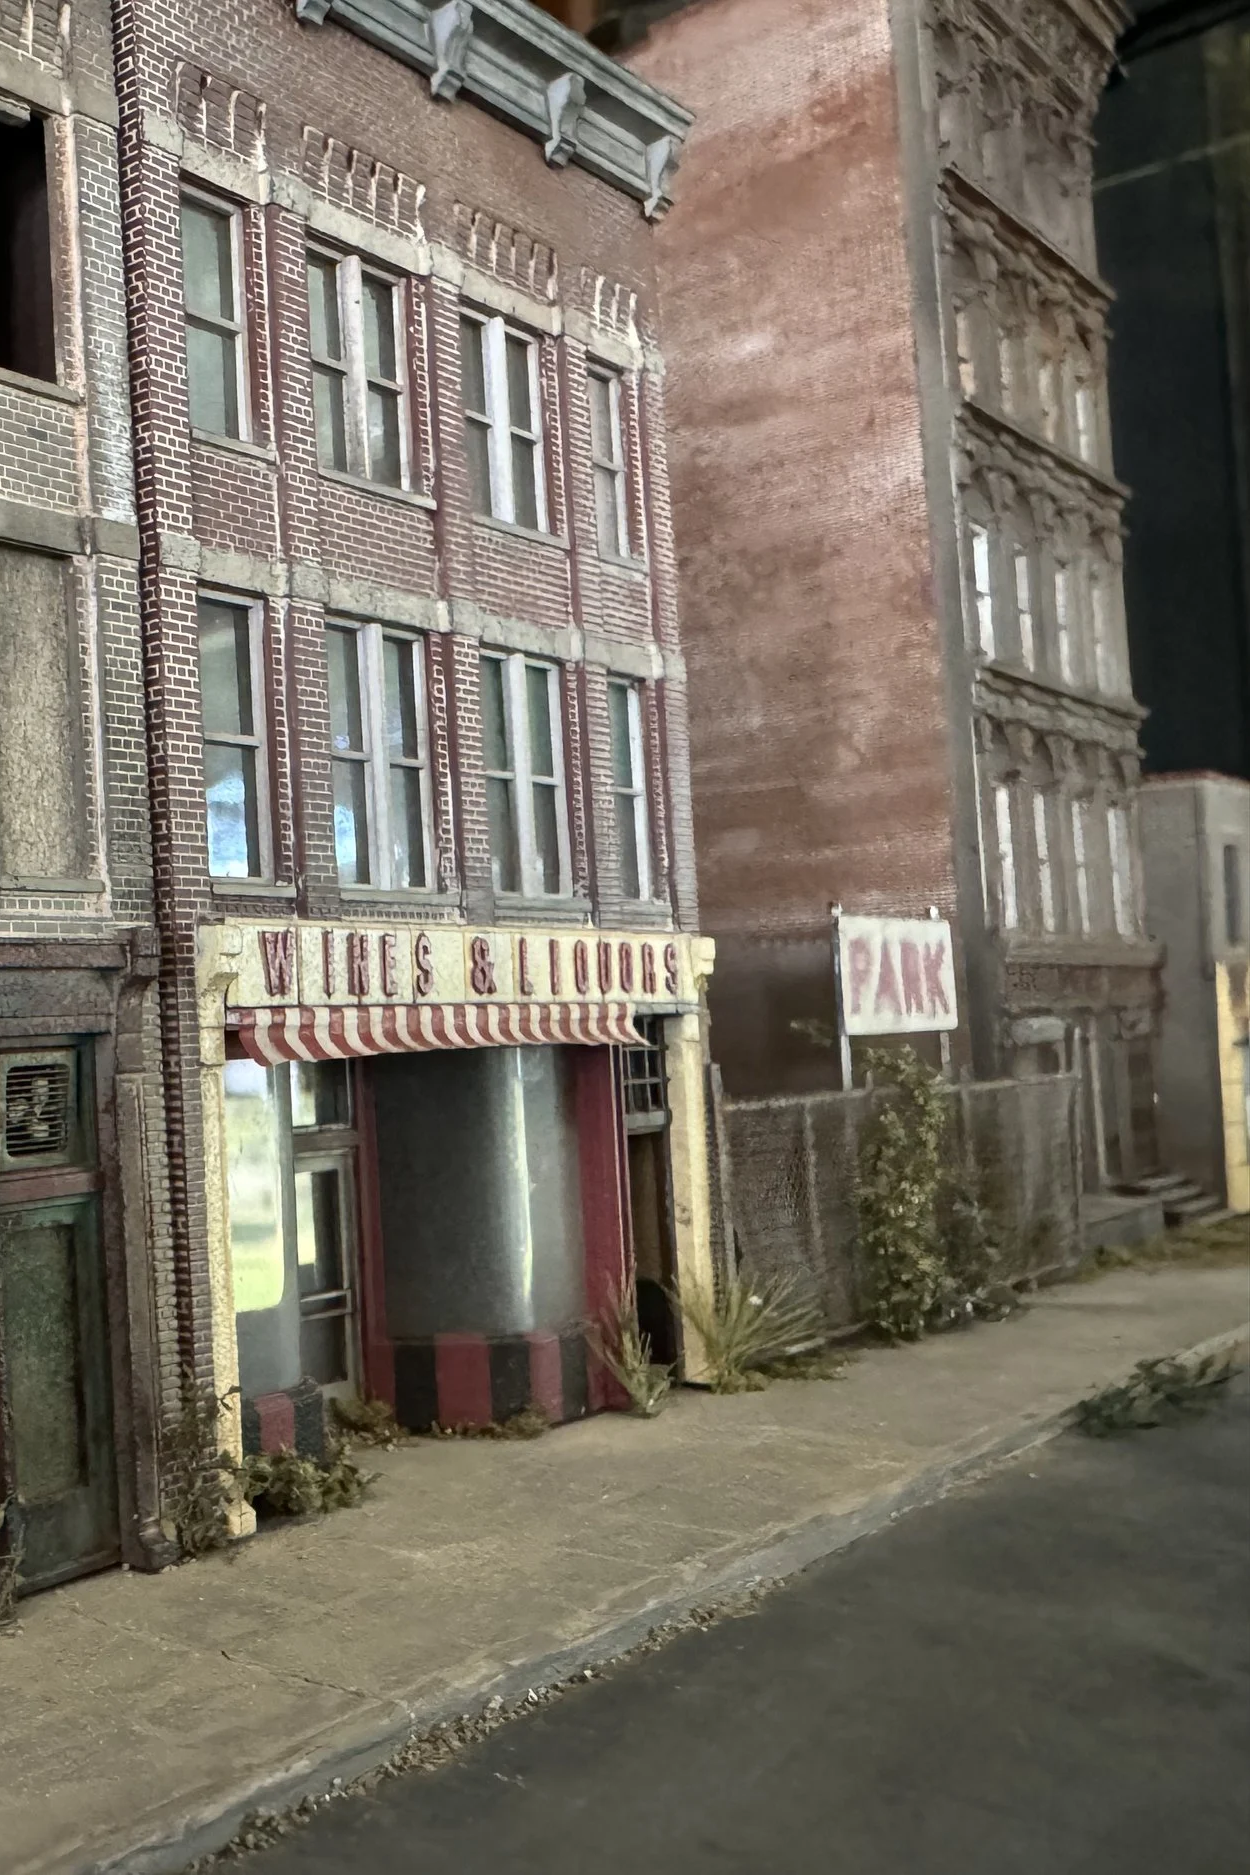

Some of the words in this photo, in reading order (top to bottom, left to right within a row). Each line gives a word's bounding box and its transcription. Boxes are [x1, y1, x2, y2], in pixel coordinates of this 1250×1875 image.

[258, 928, 434, 997] WINES
[470, 934, 497, 994] &
[848, 938, 951, 1018] PARK
